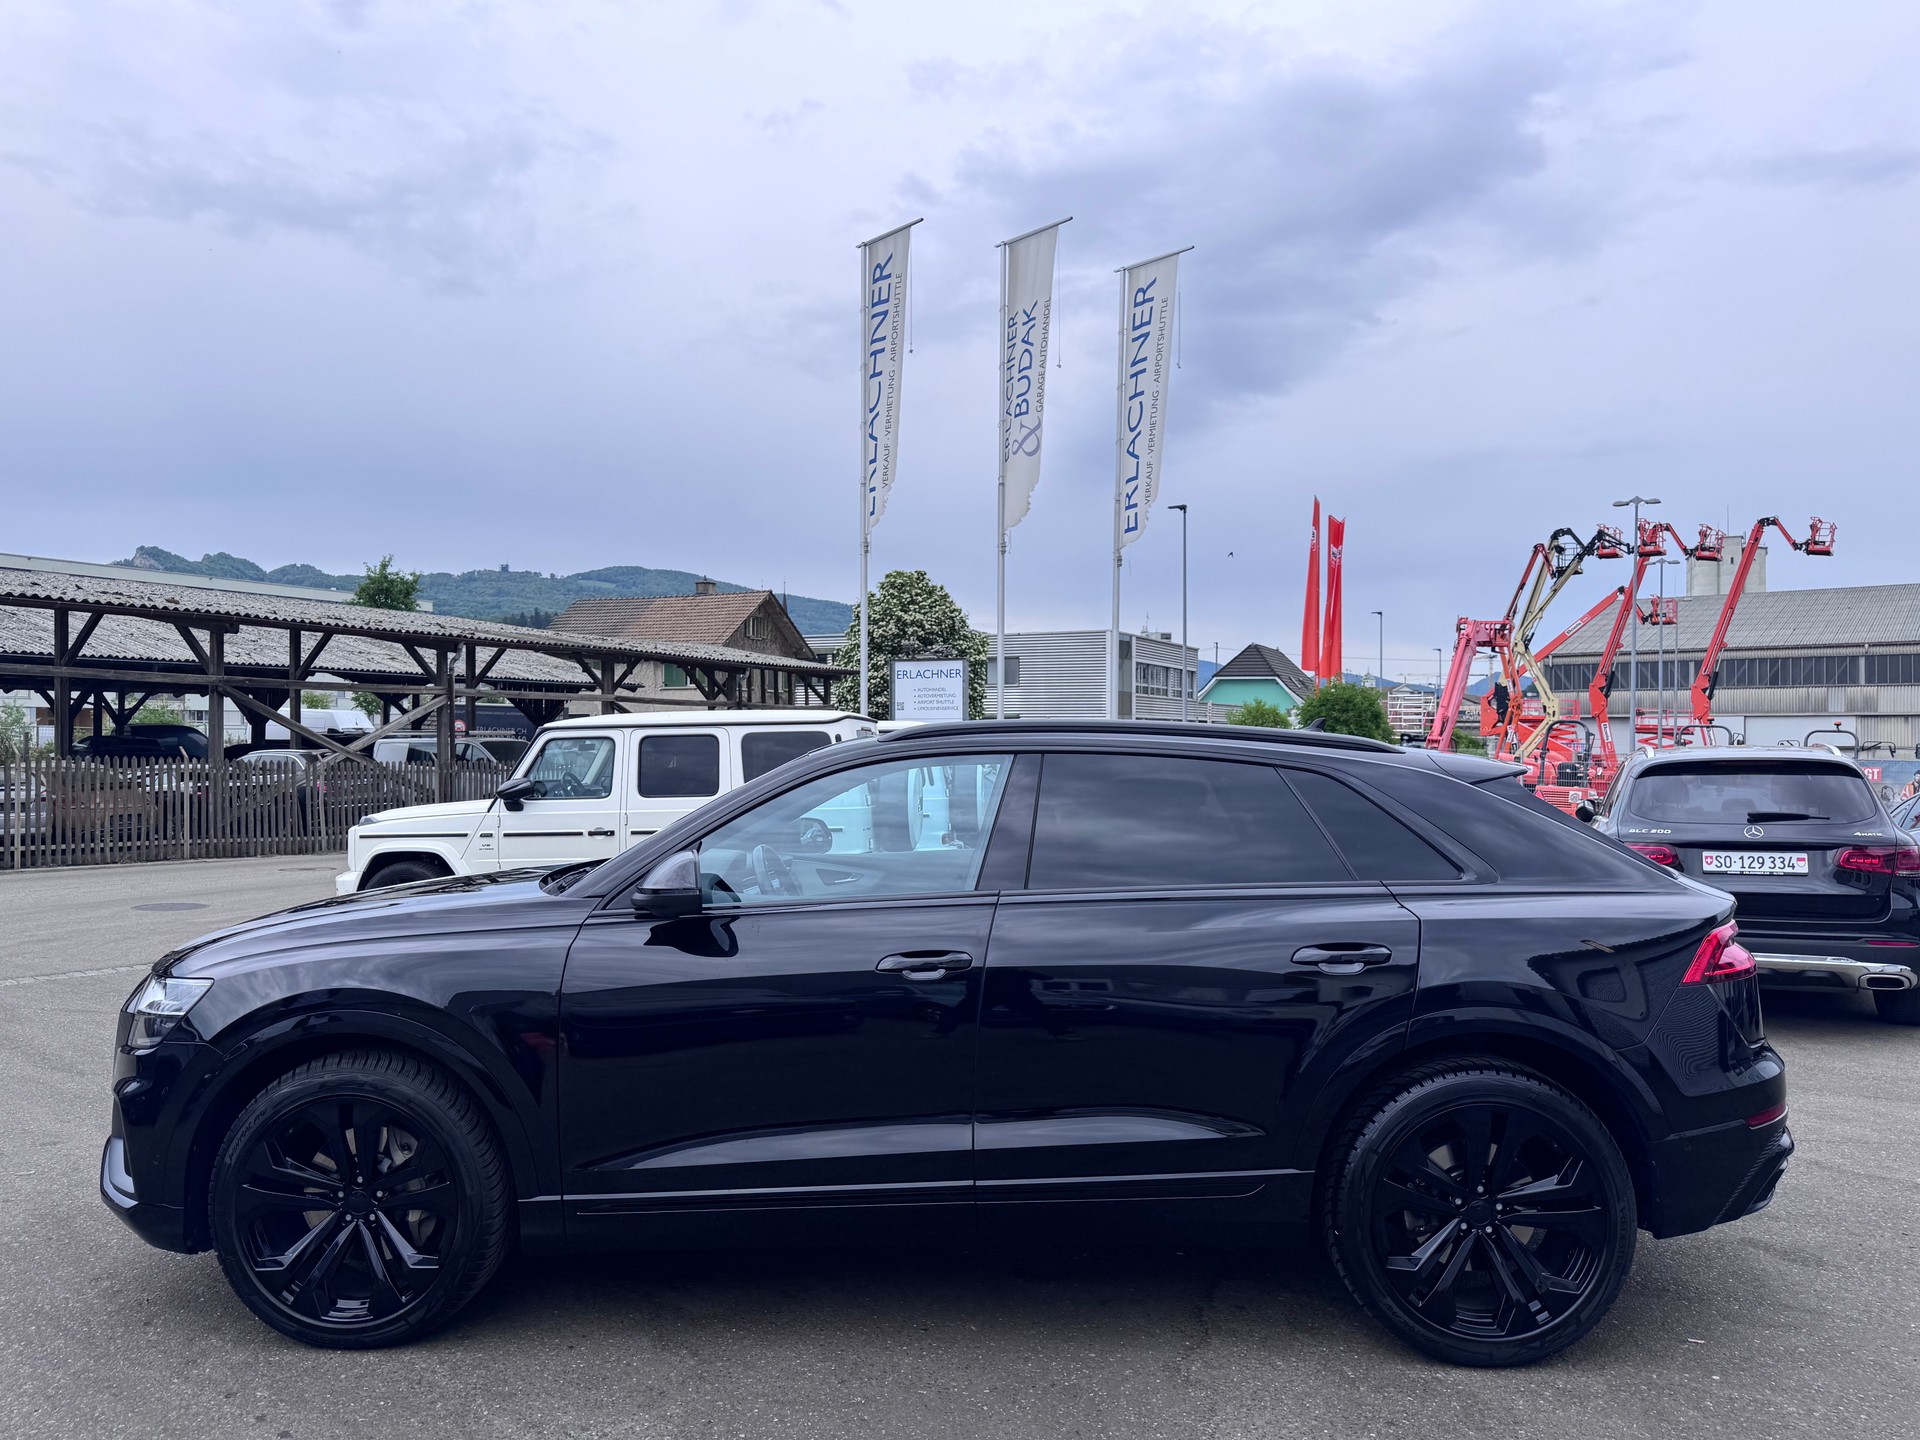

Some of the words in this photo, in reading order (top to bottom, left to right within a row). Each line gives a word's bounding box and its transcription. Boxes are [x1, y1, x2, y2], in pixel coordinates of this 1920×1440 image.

[889, 272, 903, 362] AIRPORTSHUTTLE
[1039, 296, 1052, 369] AUTOHANDEL
[1153, 296, 1168, 383] AIRPORTSHUTTLE
[1014, 299, 1038, 418] BUDAK
[1035, 370, 1046, 413] GARAGE
[885, 370, 896, 437] VERMIETUNG
[1011, 416, 1041, 457] &
[1124, 276, 1157, 534] ERLACHNER
[1148, 390, 1160, 456] VERMIETUNG
[882, 443, 891, 489] VERKAUF
[1145, 461, 1154, 505] VERKAUF
[896, 669, 962, 680] ERLACHNER
